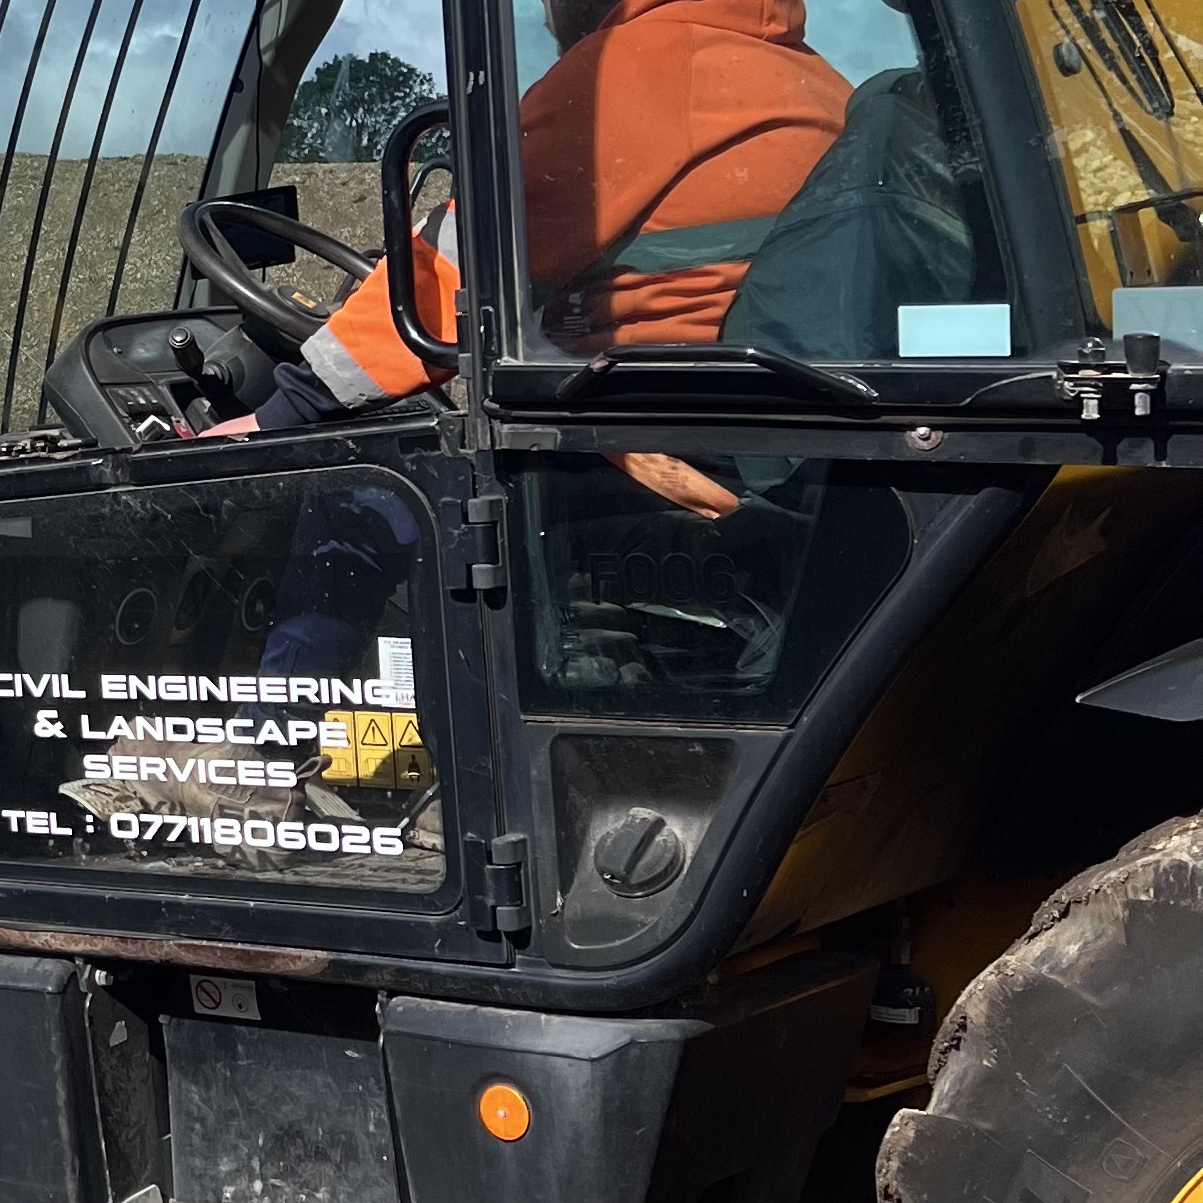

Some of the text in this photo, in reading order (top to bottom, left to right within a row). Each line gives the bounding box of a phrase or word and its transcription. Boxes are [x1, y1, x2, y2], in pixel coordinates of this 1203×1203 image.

[101, 674, 397, 706] ENGINEERING
[33, 709, 349, 748] & LANDSCAPE
[83, 753, 298, 788] SERVICES
[0, 809, 73, 836] TEL
[109, 811, 405, 857] 07711806026
